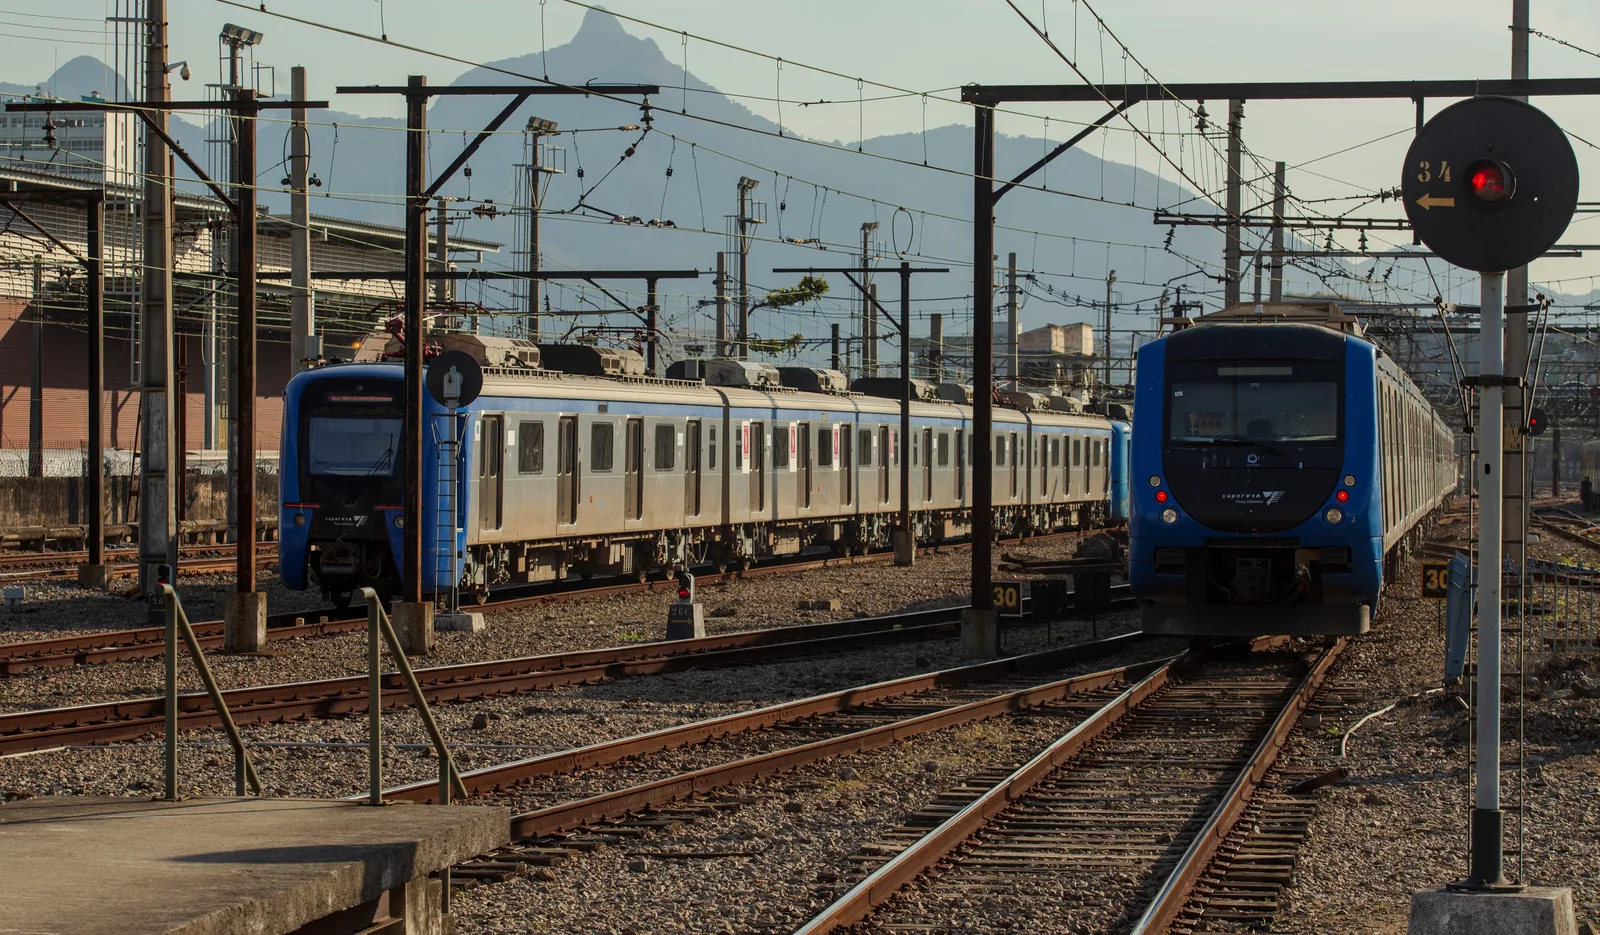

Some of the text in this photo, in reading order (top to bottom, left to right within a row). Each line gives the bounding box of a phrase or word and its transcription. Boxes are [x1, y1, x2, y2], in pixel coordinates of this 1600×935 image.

[1417, 160, 1452, 183] 34
[1426, 569, 1448, 590] 30
[992, 586, 1017, 607] 30
